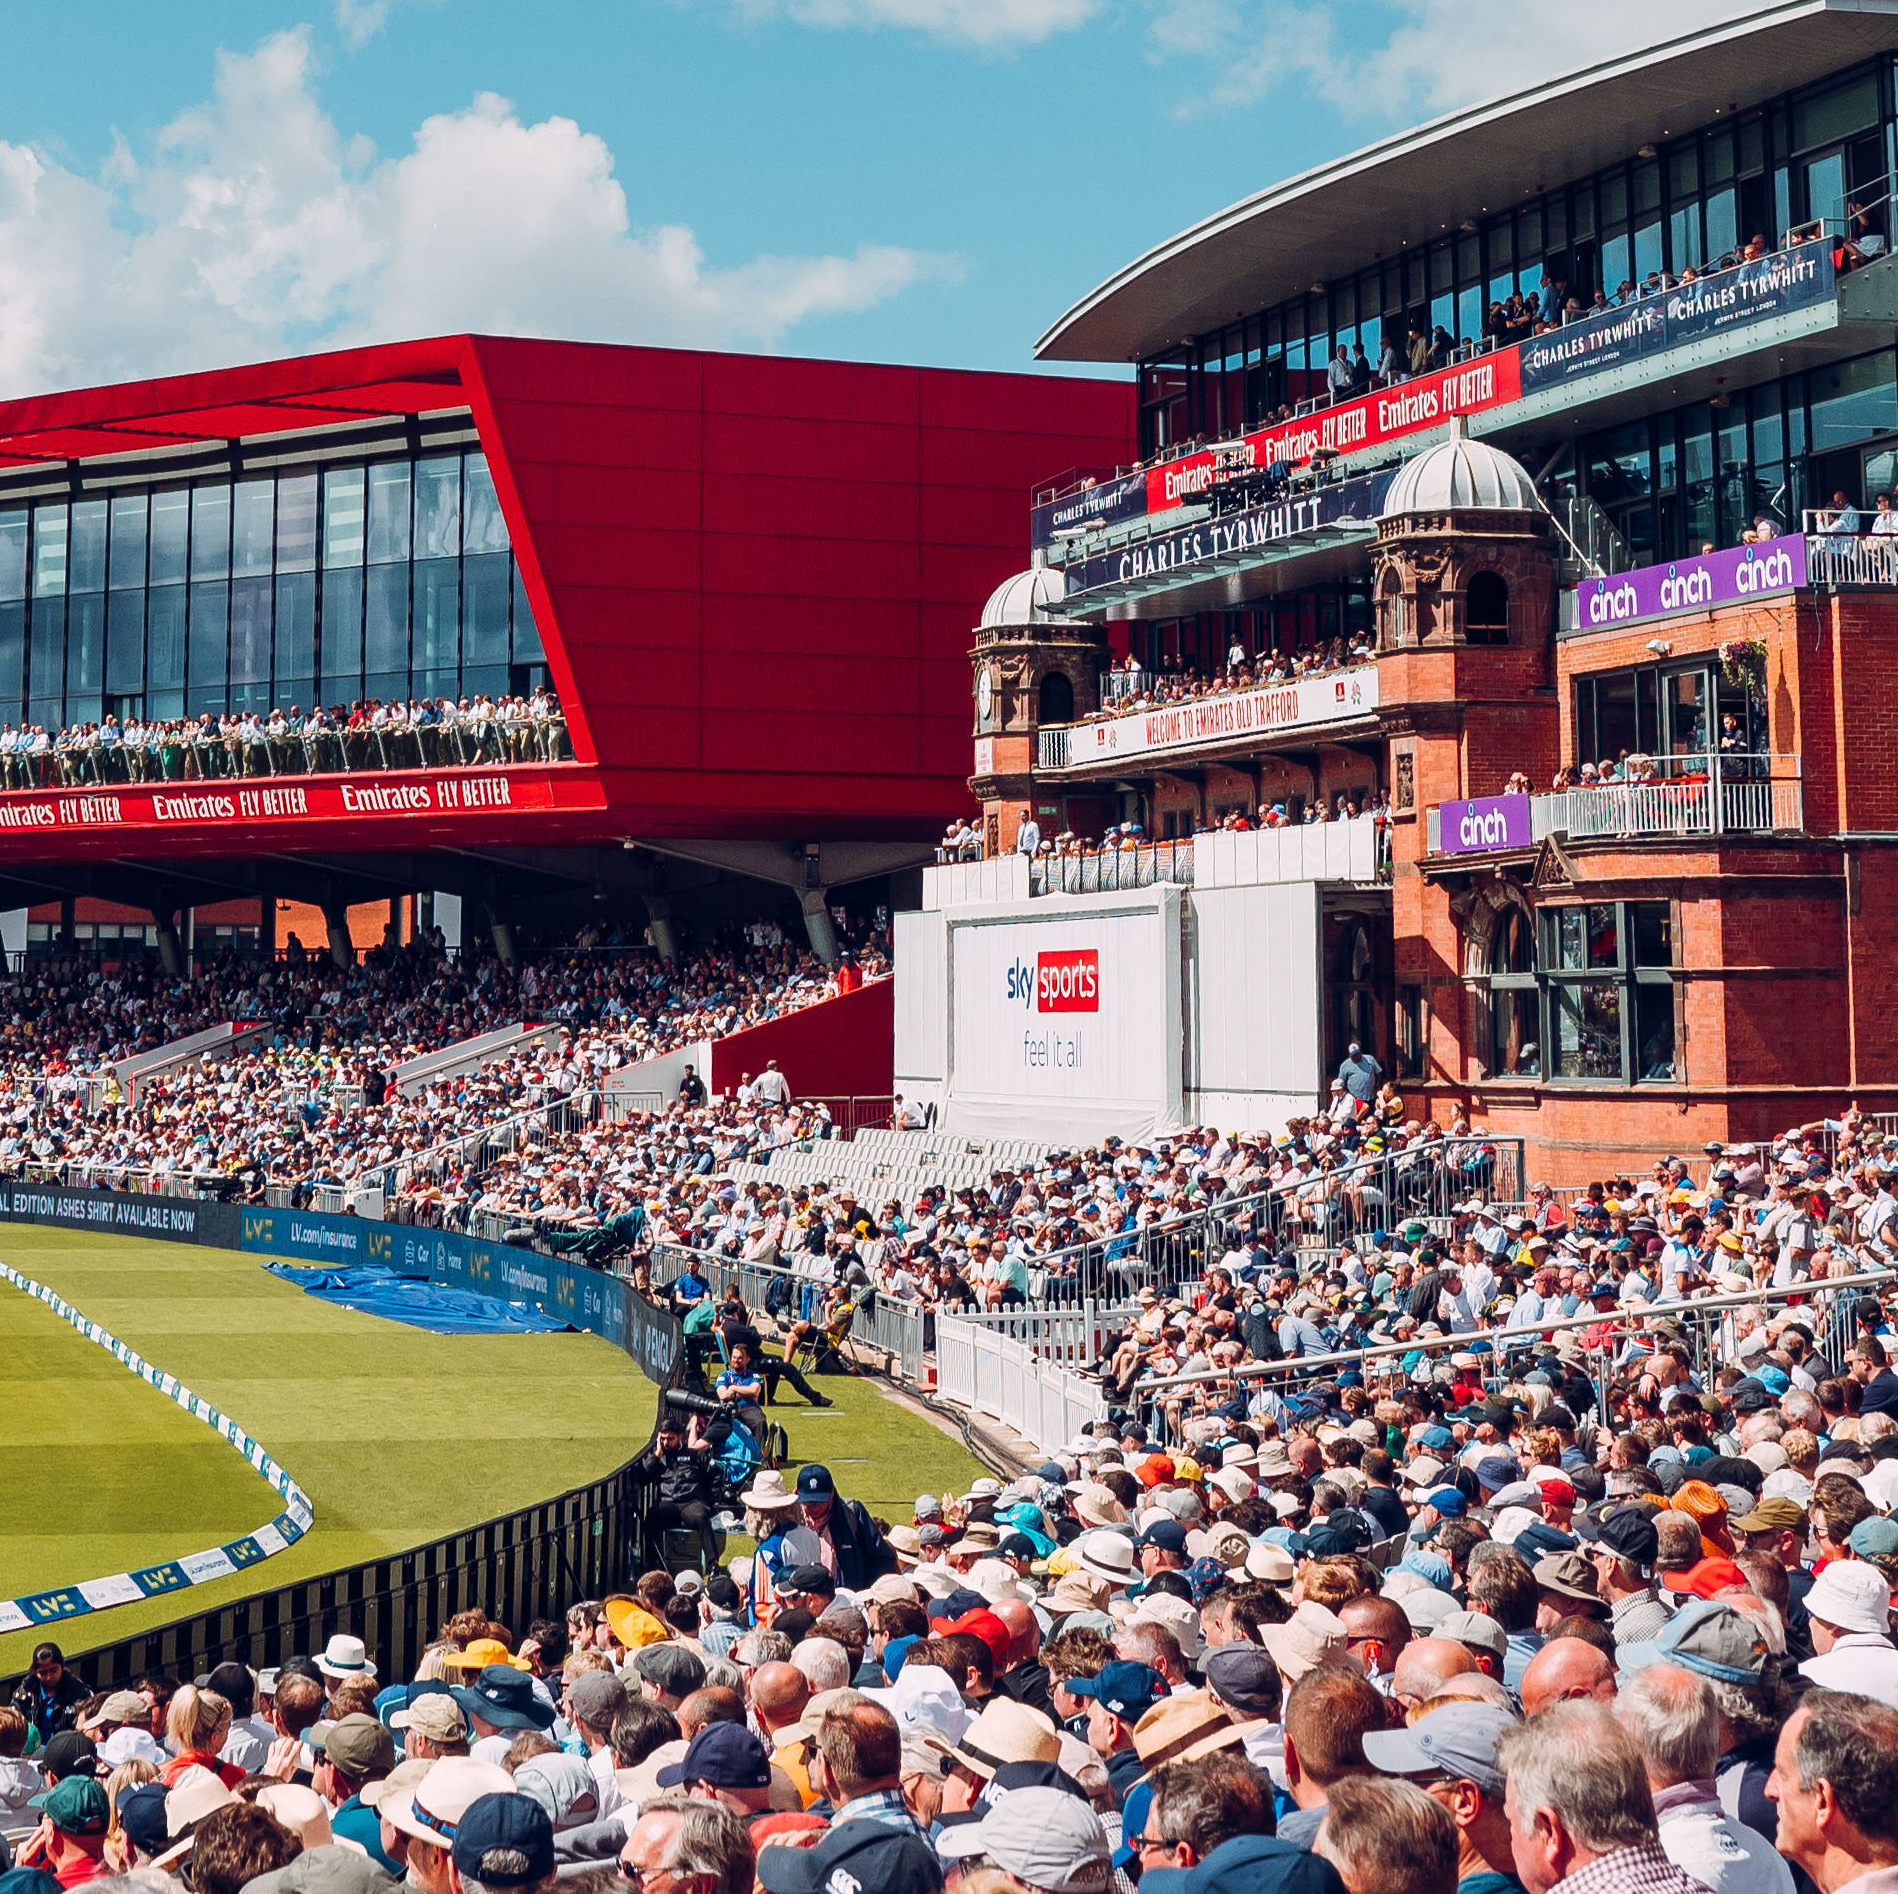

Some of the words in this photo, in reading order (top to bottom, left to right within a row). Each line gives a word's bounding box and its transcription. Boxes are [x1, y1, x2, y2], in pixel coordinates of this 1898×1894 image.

[1677, 286, 1736, 321] CHARLES
[1740, 260, 1816, 300] TYRWHITT
[1533, 337, 1584, 369] CHARLES
[1588, 314, 1652, 354] TYRWHITT
[1378, 389, 1439, 433] Emirates
[1442, 376, 1457, 412] FLY
[1459, 364, 1494, 406] BETTER
[1265, 428, 1318, 465] Emirates
[1321, 417, 1335, 450] FLY
[1337, 406, 1367, 446] BETTER
[1165, 463, 1212, 501] Emirates
[1053, 504, 1083, 525] CHARLES
[1085, 491, 1122, 515] TYRWHITT
[1119, 532, 1202, 582] CHARLES
[1209, 497, 1322, 555] TYRWHITT
[1660, 564, 1712, 609] cinch
[1736, 547, 1793, 594] cinch
[1590, 580, 1637, 624] cinch
[1145, 711, 1181, 746] WELCOME
[1183, 710, 1193, 738] TO
[1196, 702, 1234, 737] EMIRATES
[1236, 698, 1252, 729] OLD
[1254, 690, 1299, 727] TRAFFORD
[59, 800, 78, 825] FLY
[79, 797, 123, 823] BETTER
[152, 792, 235, 821] Emirates
[240, 790, 260, 817] FLY
[261, 787, 308, 816] BETTER
[341, 782, 432, 812] Emirates
[437, 781, 460, 808] FLY
[461, 778, 511, 806] BETTER
[1459, 802, 1507, 846] cinch
[1007, 956, 1034, 1009] sky
[1040, 958, 1096, 1008] sports
[1024, 1030, 1049, 1067] feel
[1053, 1030, 1062, 1067] it
[1067, 1030, 1082, 1067] all
[13, 1193, 54, 1217] EDITION
[56, 1197, 85, 1220] ASHES
[87, 1200, 114, 1223] SHIRT
[116, 1203, 168, 1229] AVAILABLE
[170, 1209, 195, 1233] NOW
[291, 1222, 357, 1249] LV.com/insurance
[417, 1245, 430, 1263] Car
